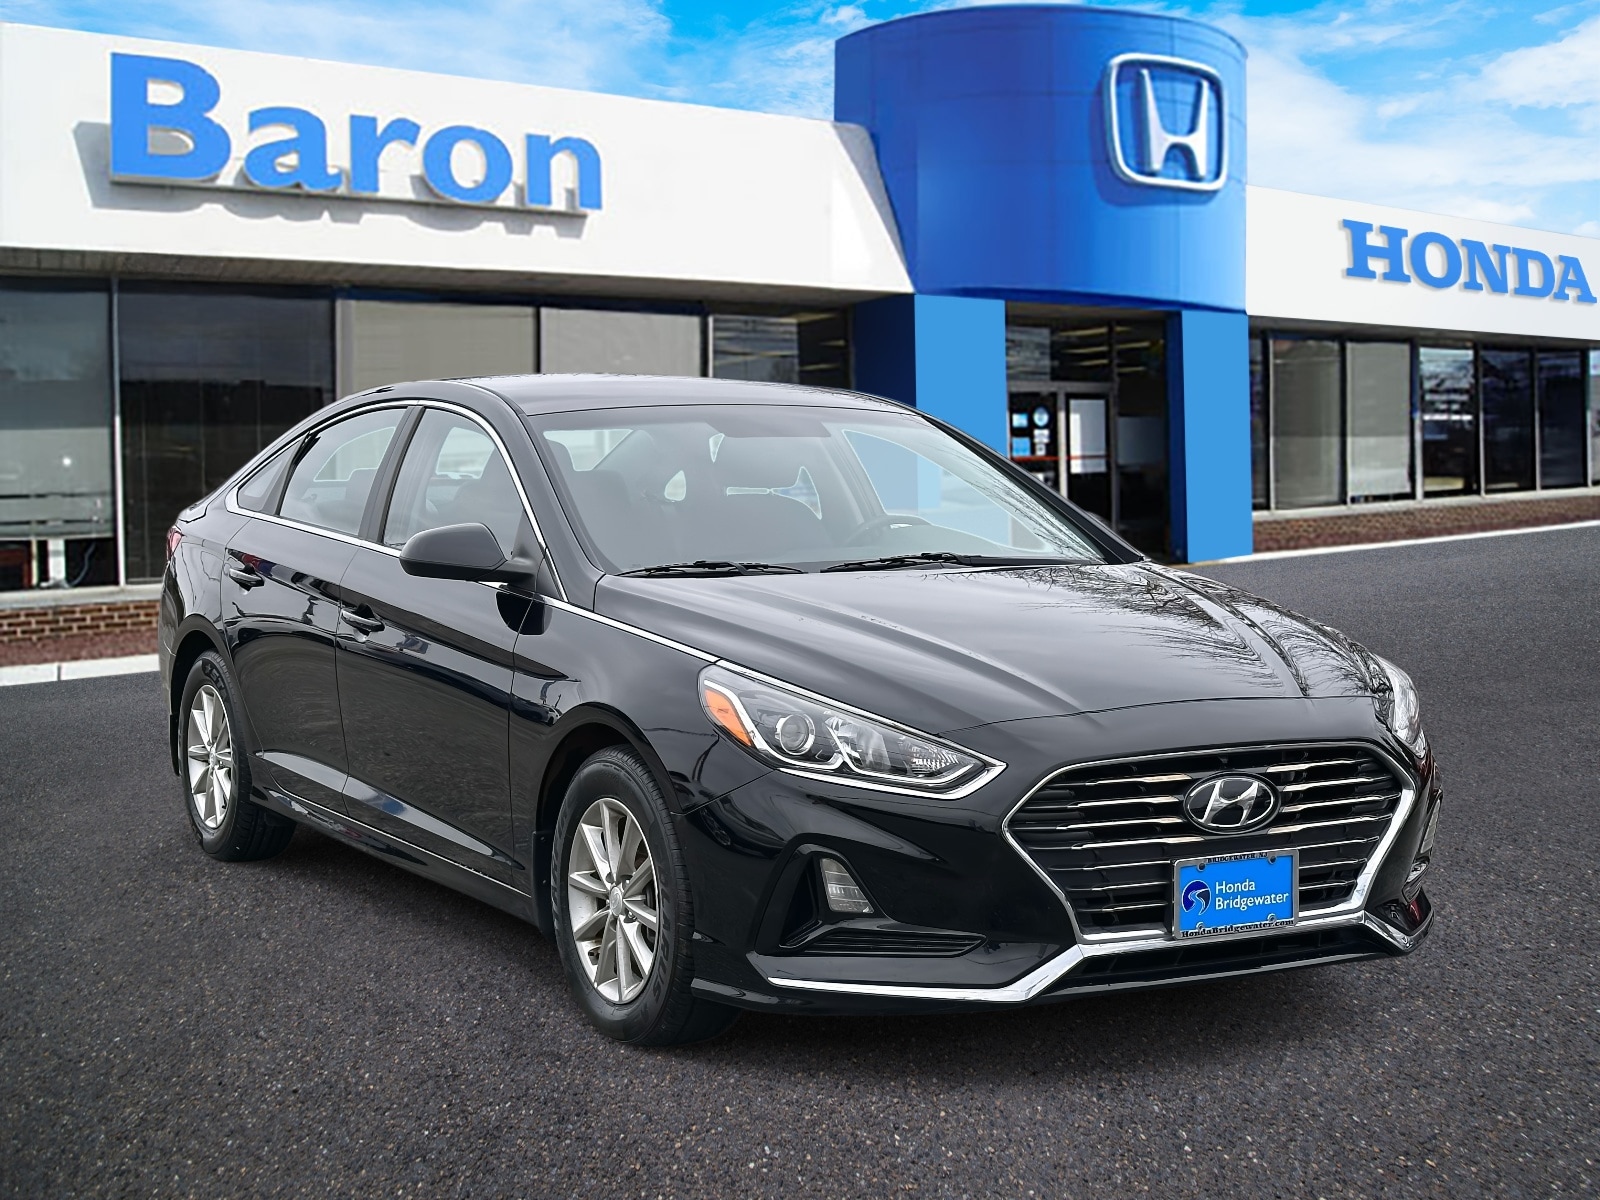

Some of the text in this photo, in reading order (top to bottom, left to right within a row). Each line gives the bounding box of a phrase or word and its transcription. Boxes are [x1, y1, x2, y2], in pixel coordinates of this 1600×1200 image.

[111, 52, 603, 210] Baron
[1343, 219, 1598, 304] HONDA
[1215, 879, 1256, 894] Honda
[1215, 892, 1290, 911] Bridgewater
[1181, 920, 1294, 938] HondaBridgewater.com
